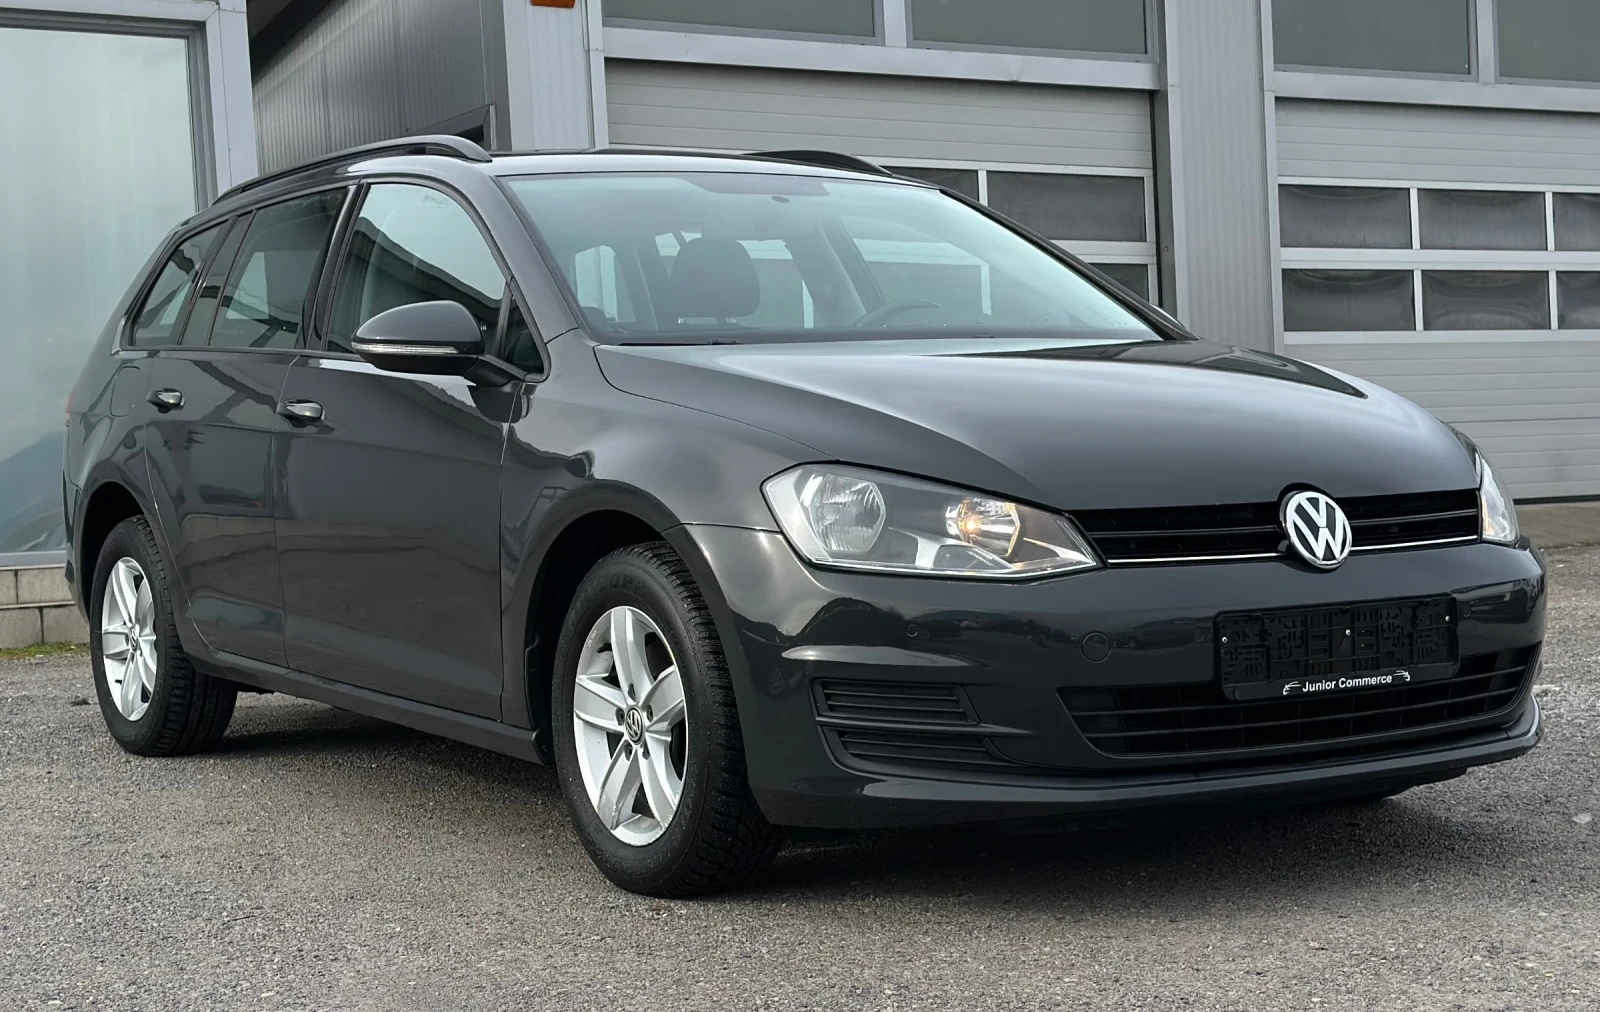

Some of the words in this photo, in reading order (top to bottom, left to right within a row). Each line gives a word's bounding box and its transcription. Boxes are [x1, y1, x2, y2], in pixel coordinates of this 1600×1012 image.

[1286, 491, 1352, 566] VW
[1302, 680, 1337, 692] Junior
[1338, 674, 1393, 689] Commerce
